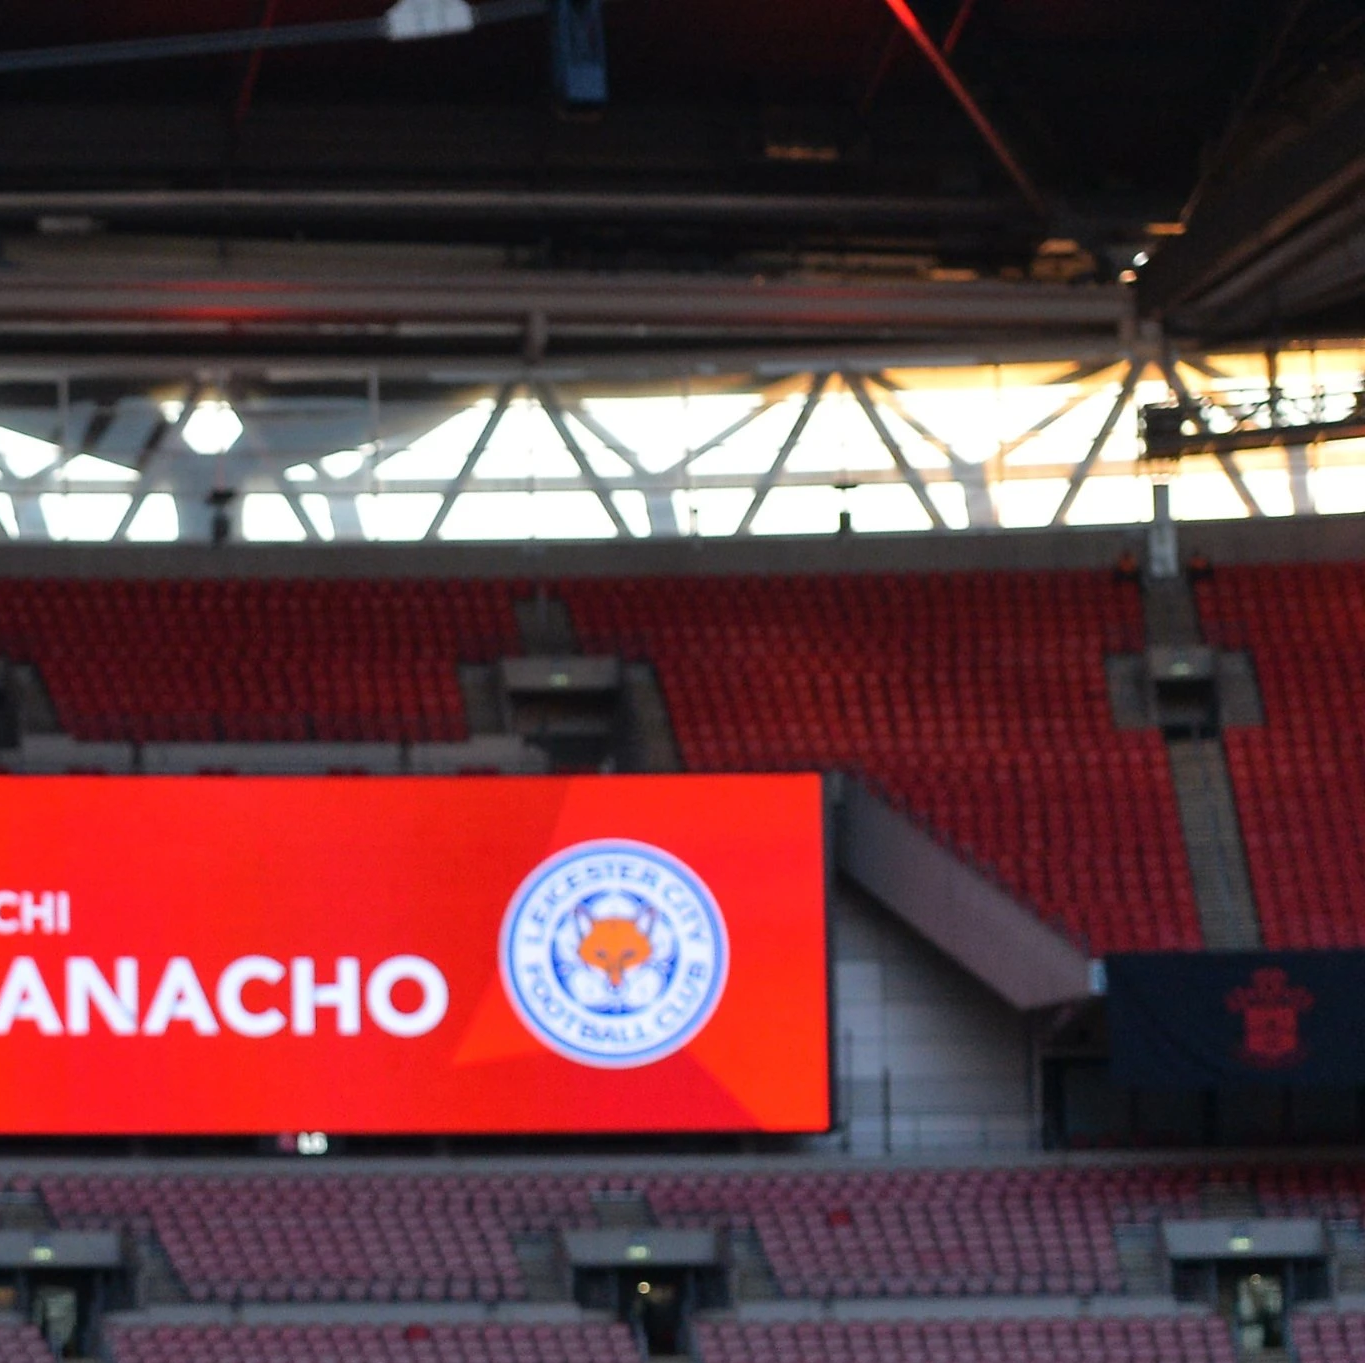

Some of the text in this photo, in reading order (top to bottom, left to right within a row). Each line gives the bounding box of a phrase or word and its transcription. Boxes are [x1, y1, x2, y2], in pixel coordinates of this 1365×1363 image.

[526, 862, 704, 943] LEICESTER CITY
[526, 961, 706, 1043] FOOTBALL CLUB
